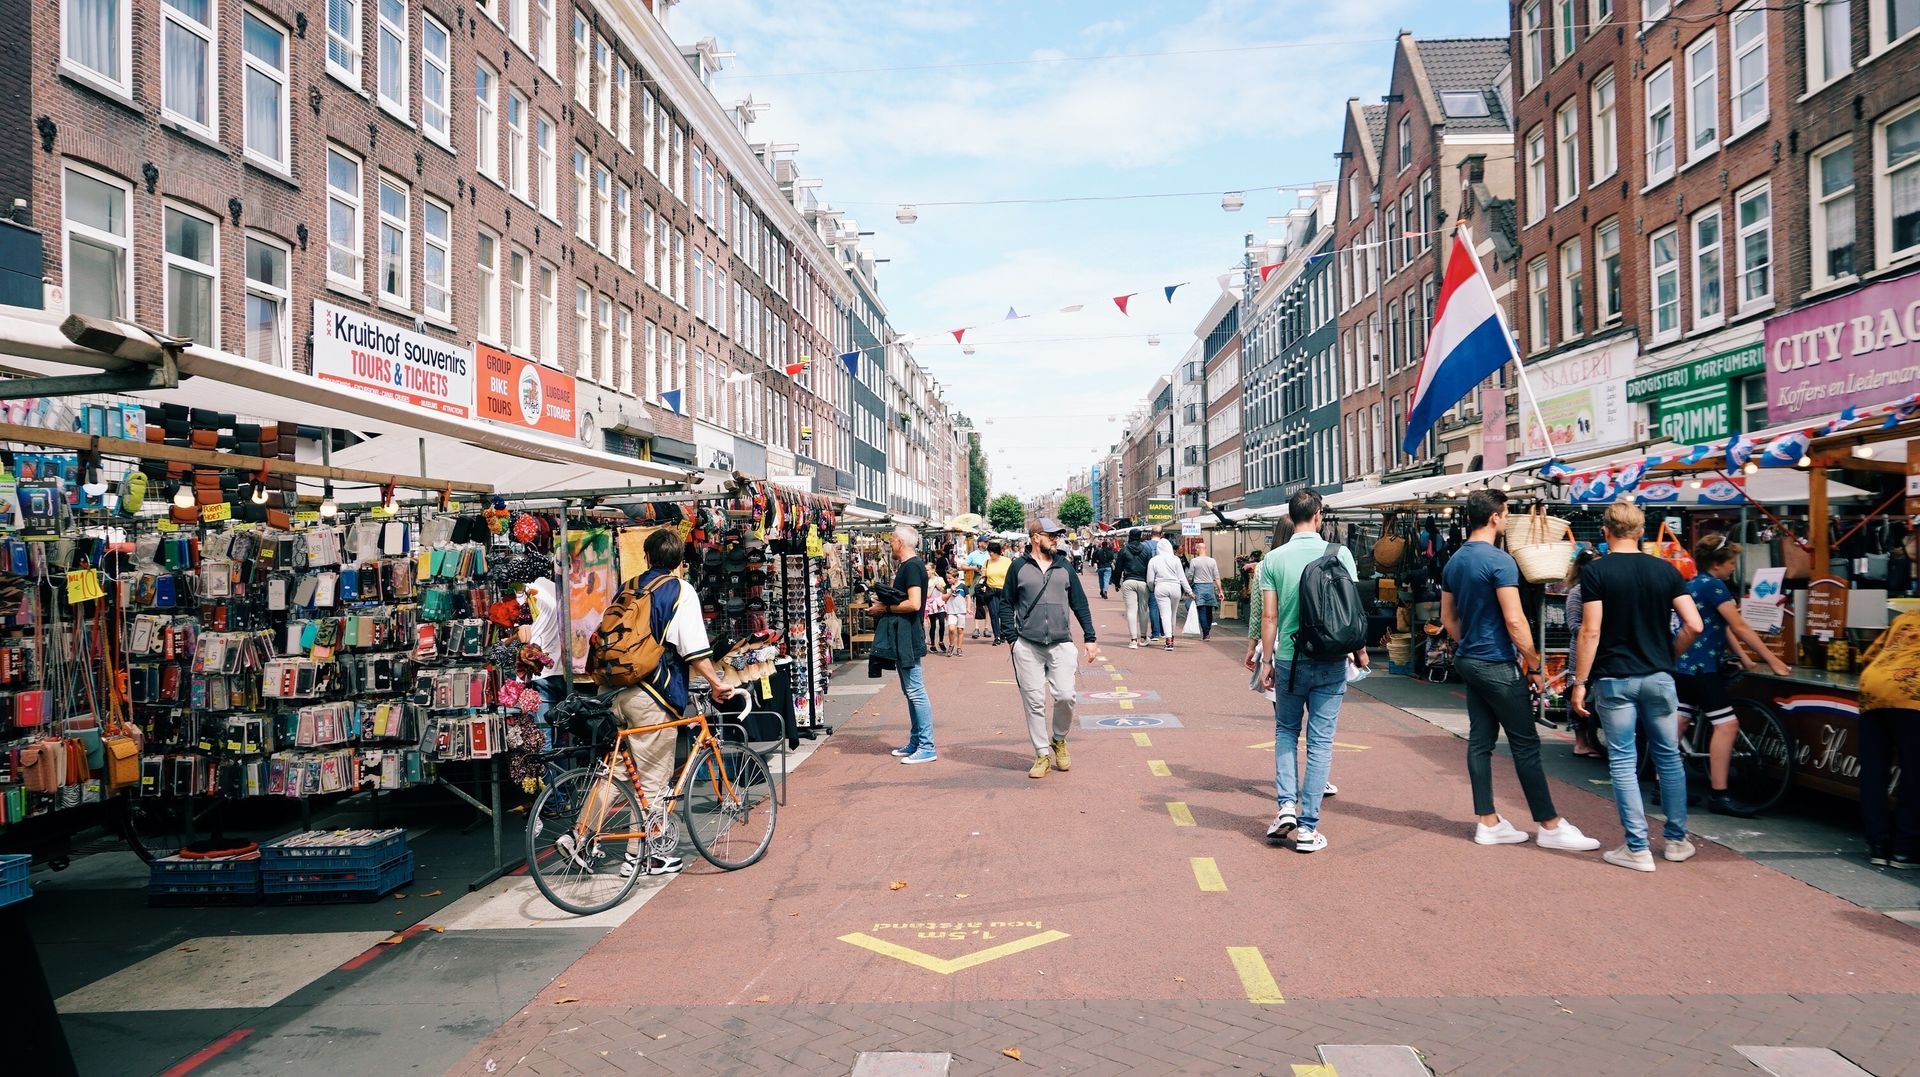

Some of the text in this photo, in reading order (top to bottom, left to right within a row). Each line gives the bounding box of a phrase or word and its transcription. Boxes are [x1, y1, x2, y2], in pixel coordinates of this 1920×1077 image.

[335, 313, 466, 376] Kruithof souvenirs
[1774, 322, 1846, 373] CITY
[351, 350, 448, 397] TOURS & TICKETS
[487, 355, 511, 375] GROUP
[490, 376, 508, 395] BIKE
[546, 385, 570, 403] LUGGAGE
[1627, 368, 1688, 398] DROGISTERIJ
[1777, 380, 1826, 413] Koffers
[1829, 383, 1845, 396] en
[488, 397, 512, 416] TOURS
[546, 404, 571, 421] STORAGE
[1661, 403, 1728, 444] GRIMME
[80, 569, 97, 600] 10
[872, 920, 1042, 932] hou afstand
